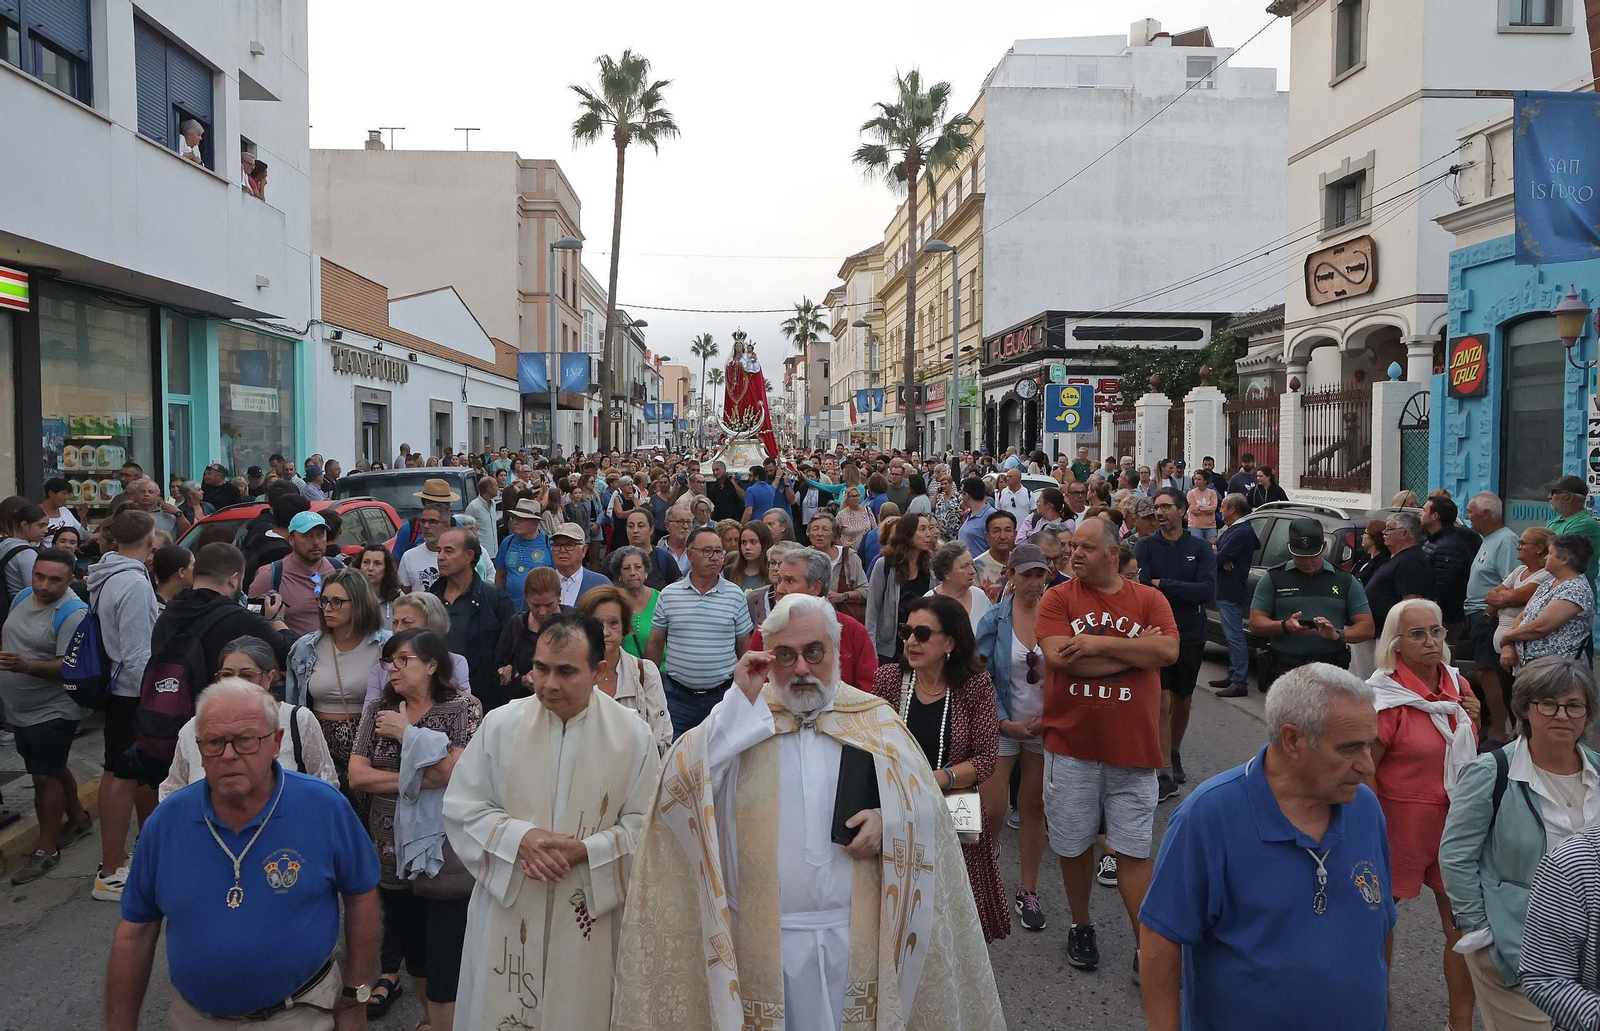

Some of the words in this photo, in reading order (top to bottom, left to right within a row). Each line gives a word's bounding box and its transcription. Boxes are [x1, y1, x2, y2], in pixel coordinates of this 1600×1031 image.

[1449, 344, 1483, 369] SANTA
[1453, 363, 1480, 386] CRUZ
[1511, 502, 1558, 521] DUOTON
[1070, 611, 1146, 639] BEACH
[1069, 683, 1132, 701] CLUB
[493, 936, 538, 1010] JHS
